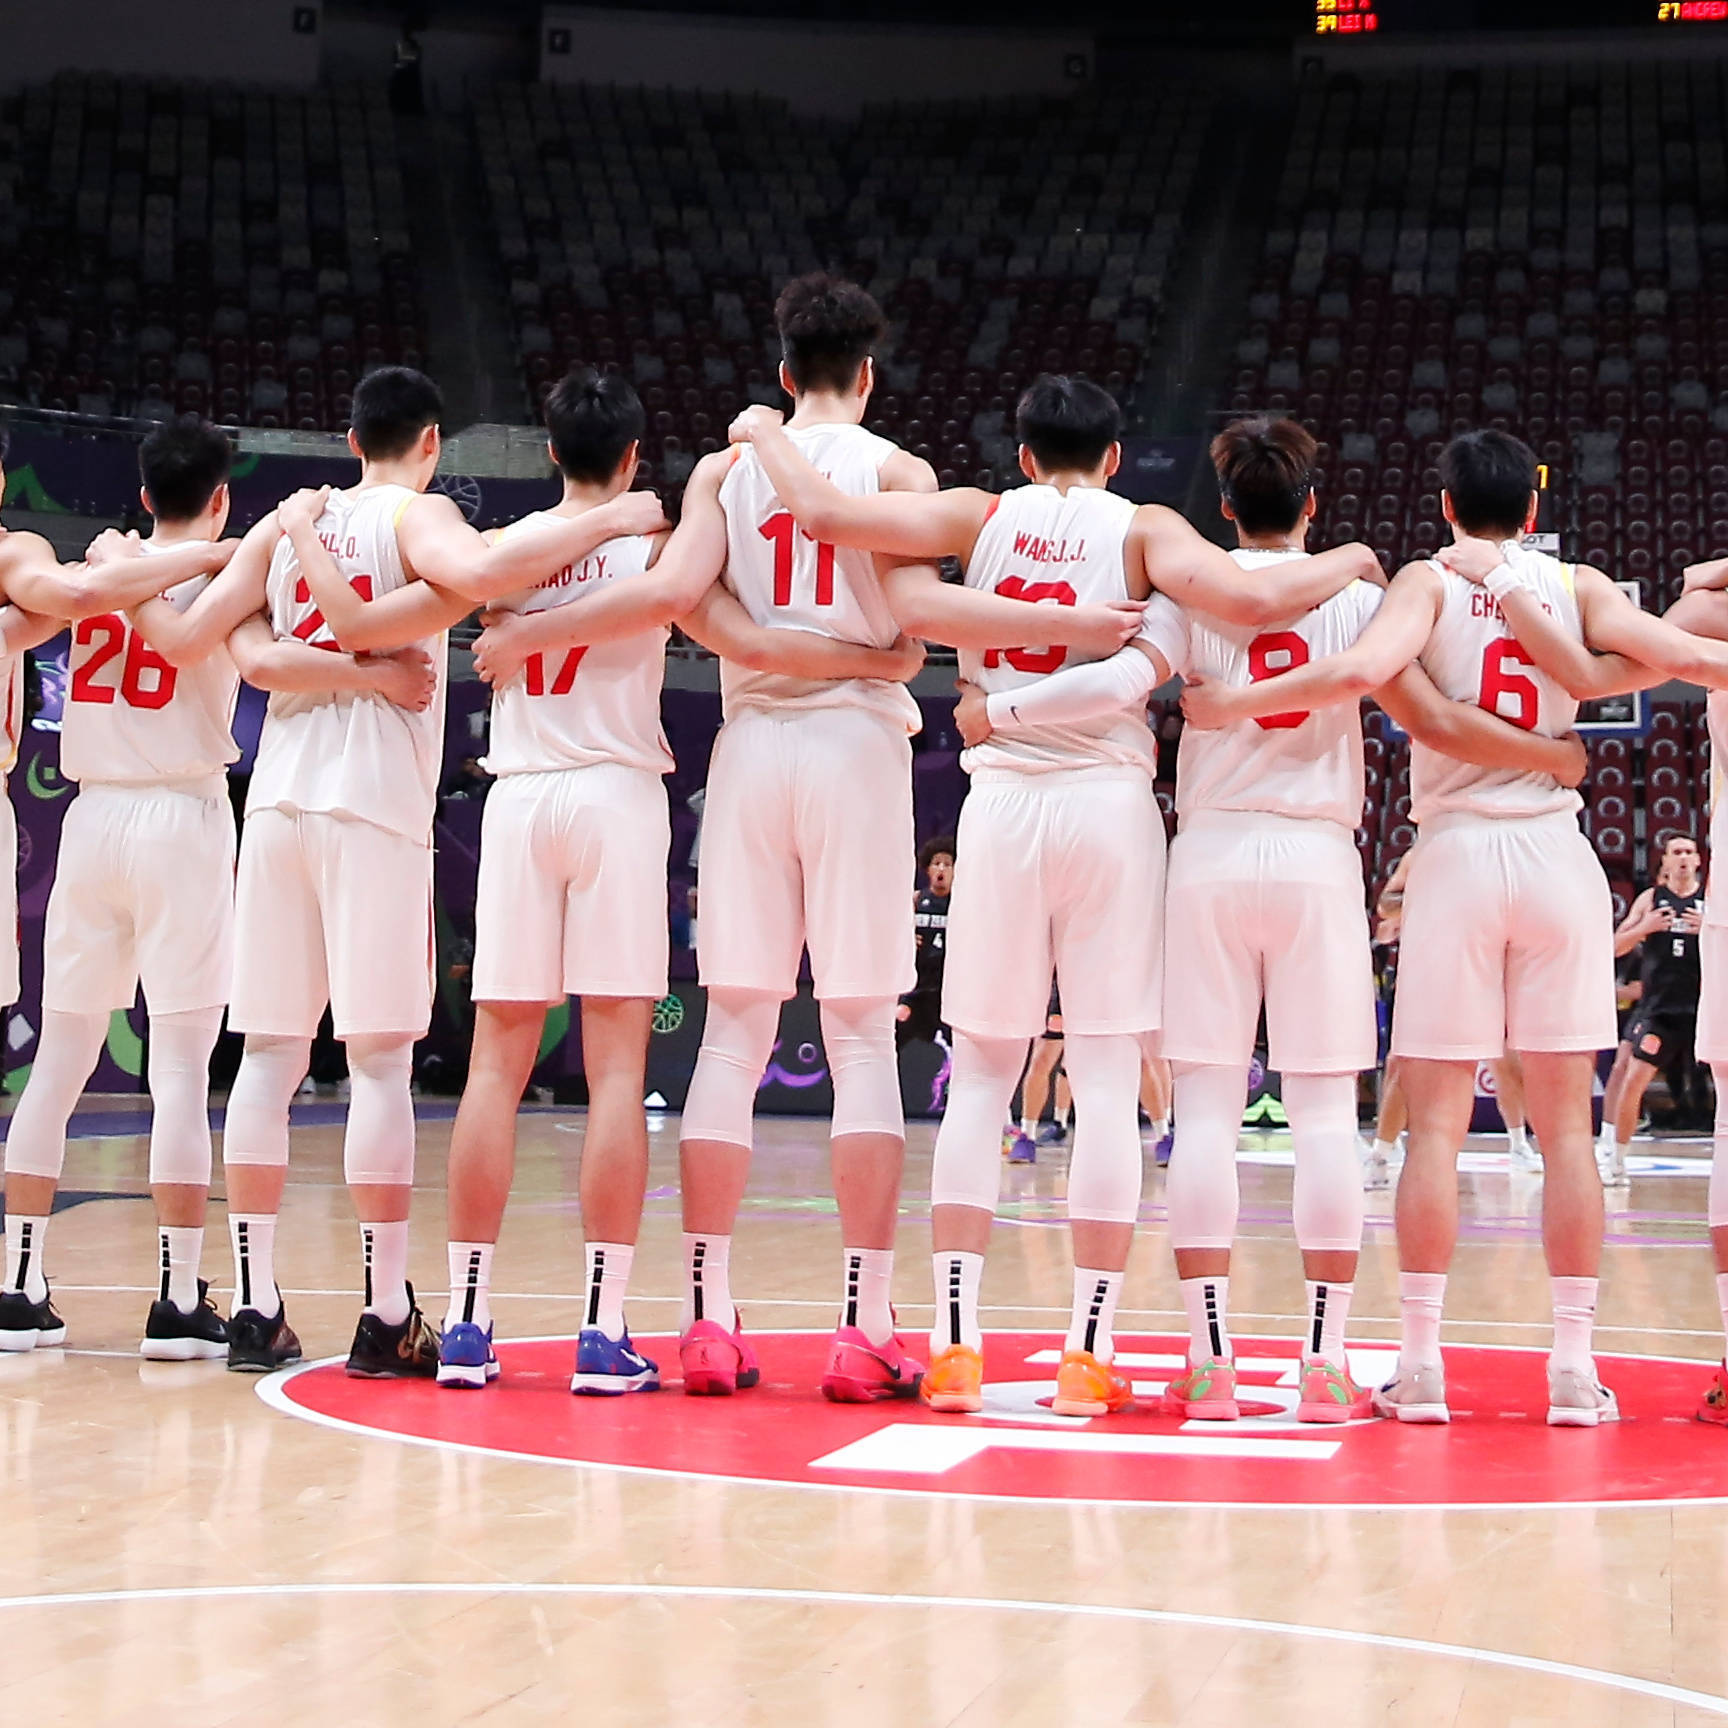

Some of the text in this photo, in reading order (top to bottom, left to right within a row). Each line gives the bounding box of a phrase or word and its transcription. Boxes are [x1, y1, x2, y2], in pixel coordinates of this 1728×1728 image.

[1317, 15, 1337, 32] 39
[1338, 14, 1361, 33] LEI
[1658, 2, 1680, 20] 27
[577, 555, 613, 582] J.Y.
[759, 512, 835, 606] 11
[71, 613, 178, 709] 26
[1248, 631, 1310, 730] 8
[1479, 638, 1539, 731] 6
[1673, 939, 1685, 957] 5
